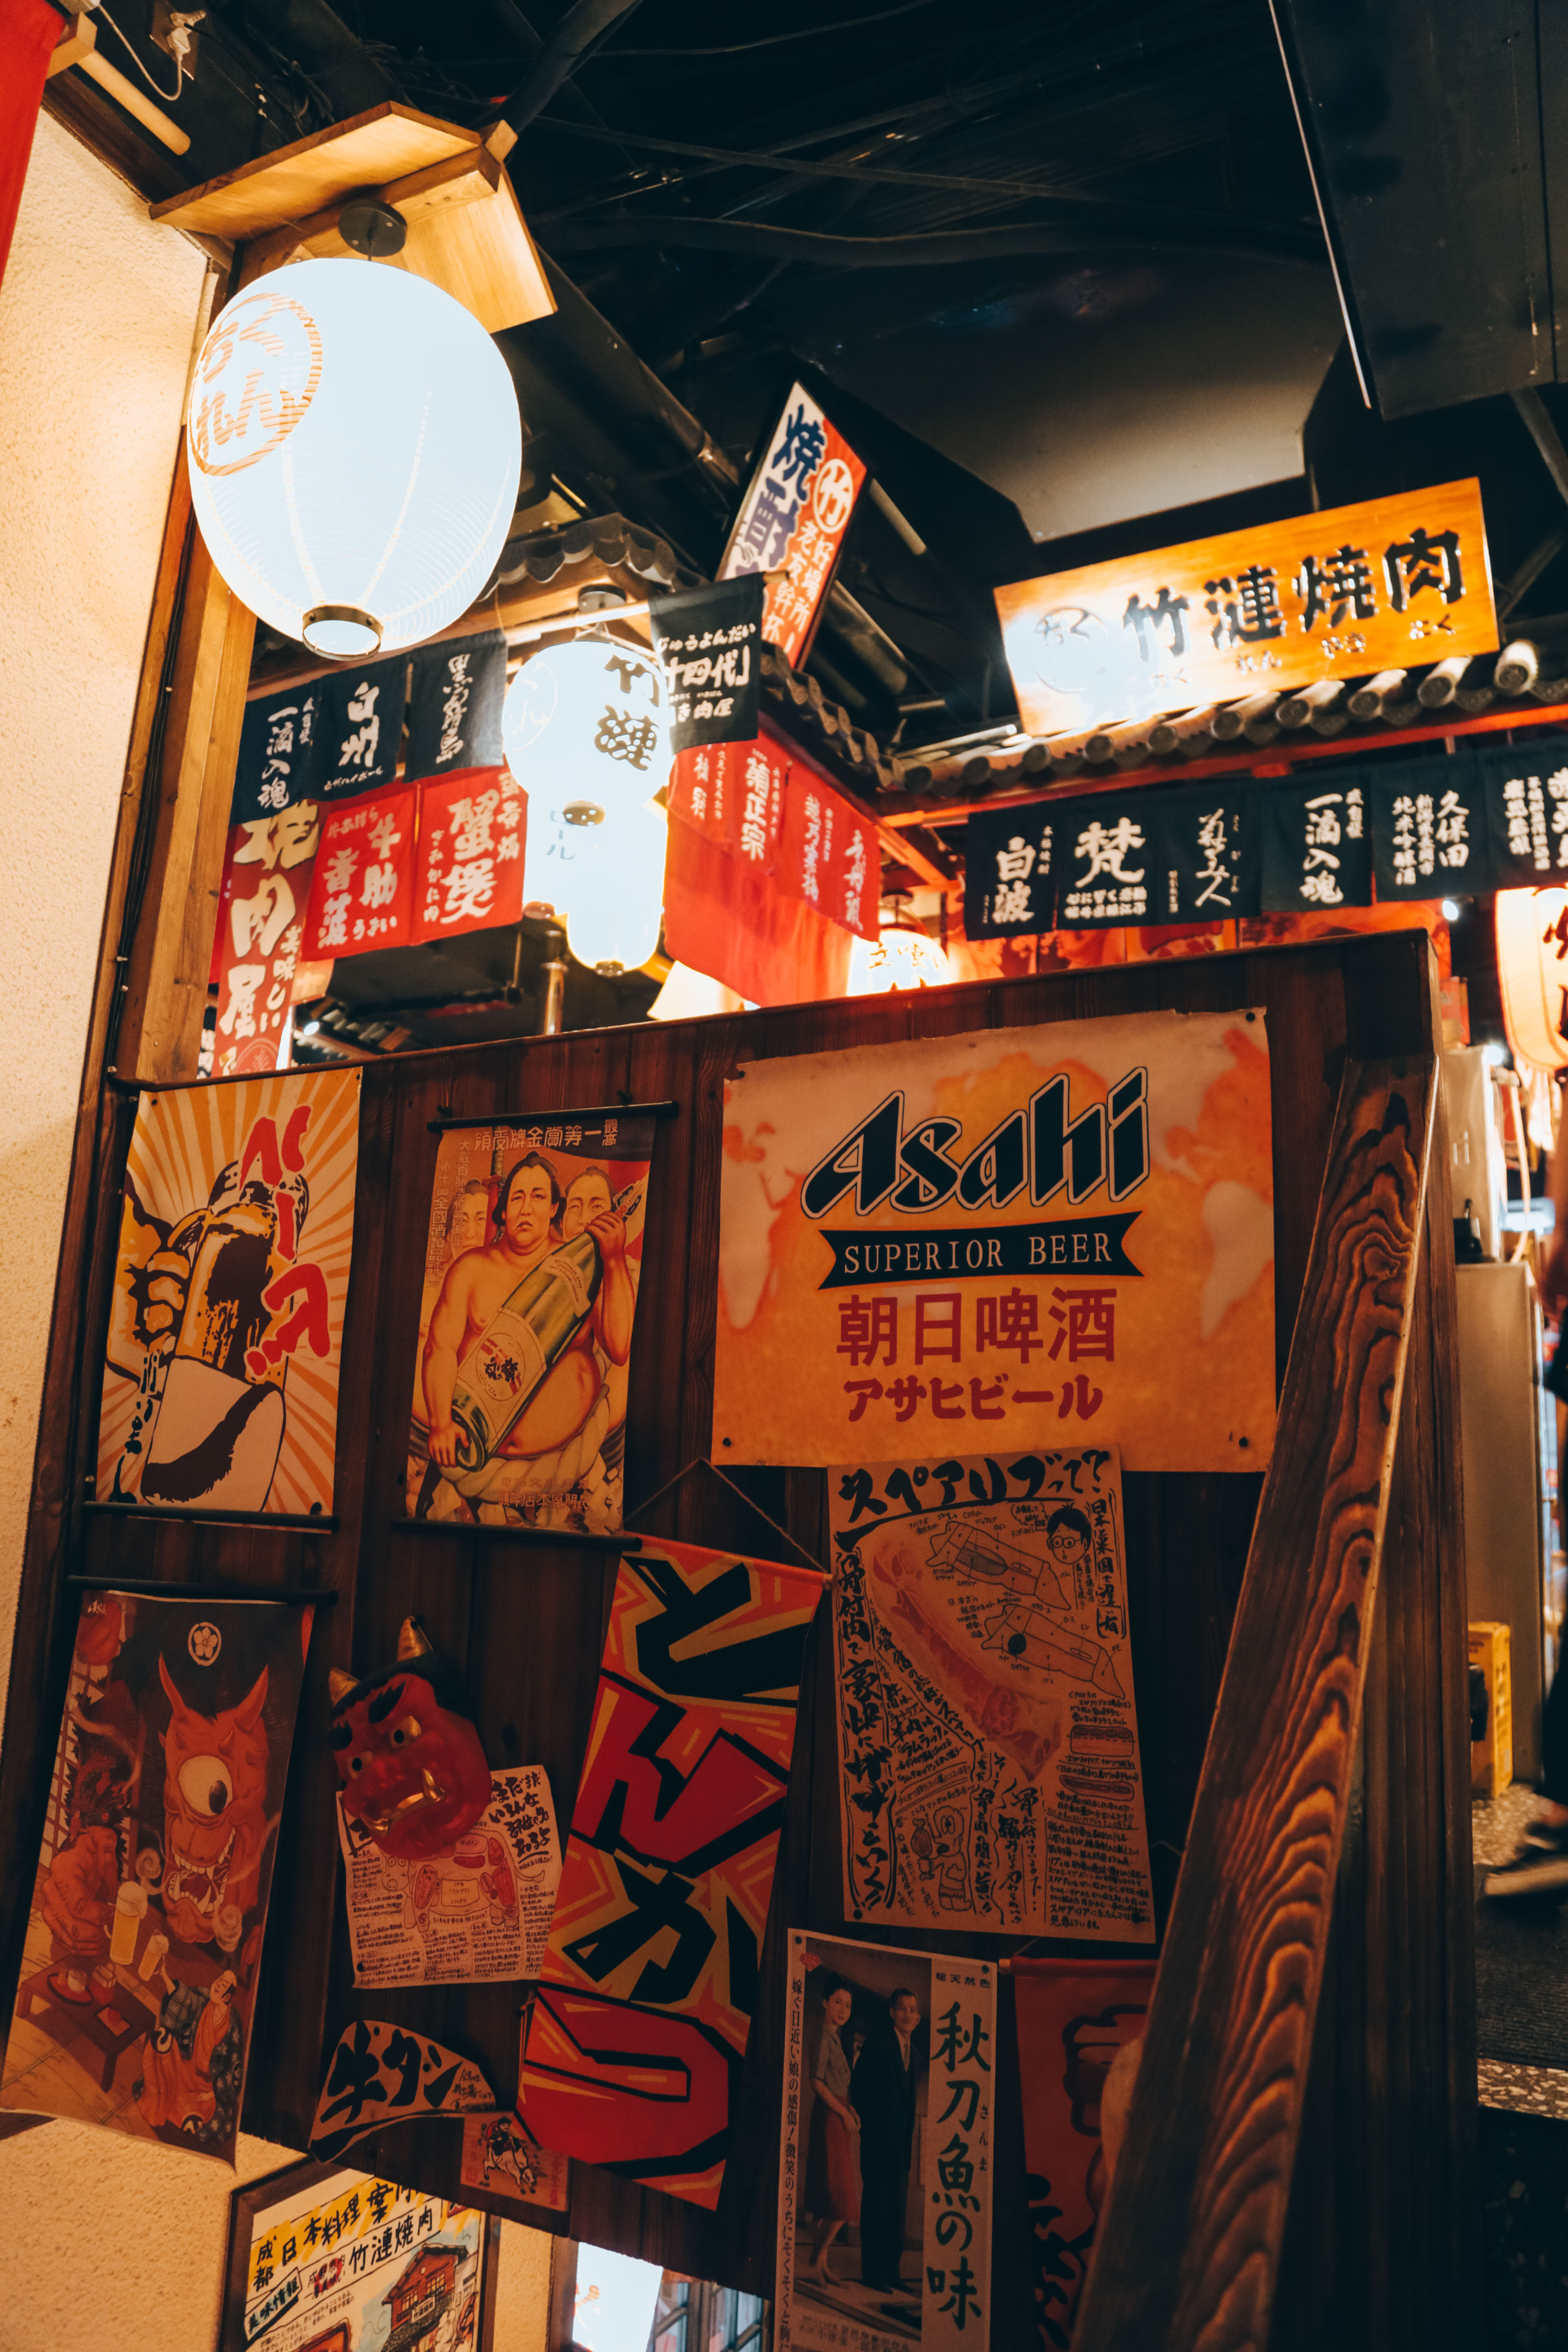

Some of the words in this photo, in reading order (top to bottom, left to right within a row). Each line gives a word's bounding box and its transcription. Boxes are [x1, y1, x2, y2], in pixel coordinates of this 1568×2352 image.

[257, 707, 298, 809] 一滴入魂
[339, 682, 380, 768] 白州
[1074, 817, 1146, 889] 梵
[1299, 793, 1343, 904] 一滴入魂
[1436, 790, 1470, 867] 久保田
[992, 836, 1036, 924] 白波
[260, 924, 301, 1034] 美味しい
[801, 1067, 1150, 1219] Asahi
[844, 1238, 1004, 1274] SUPERIOR
[1029, 1233, 1112, 1265] BEER
[837, 1287, 1117, 1367] 朝日啤酒
[843, 1373, 1103, 1423] アサヒビール
[927, 2001, 991, 2331] 秋刀魚の味
[979, 2105, 991, 2173] さんま
[253, 2234, 276, 2292] 成都
[247, 2276, 300, 2331] 美味情報
